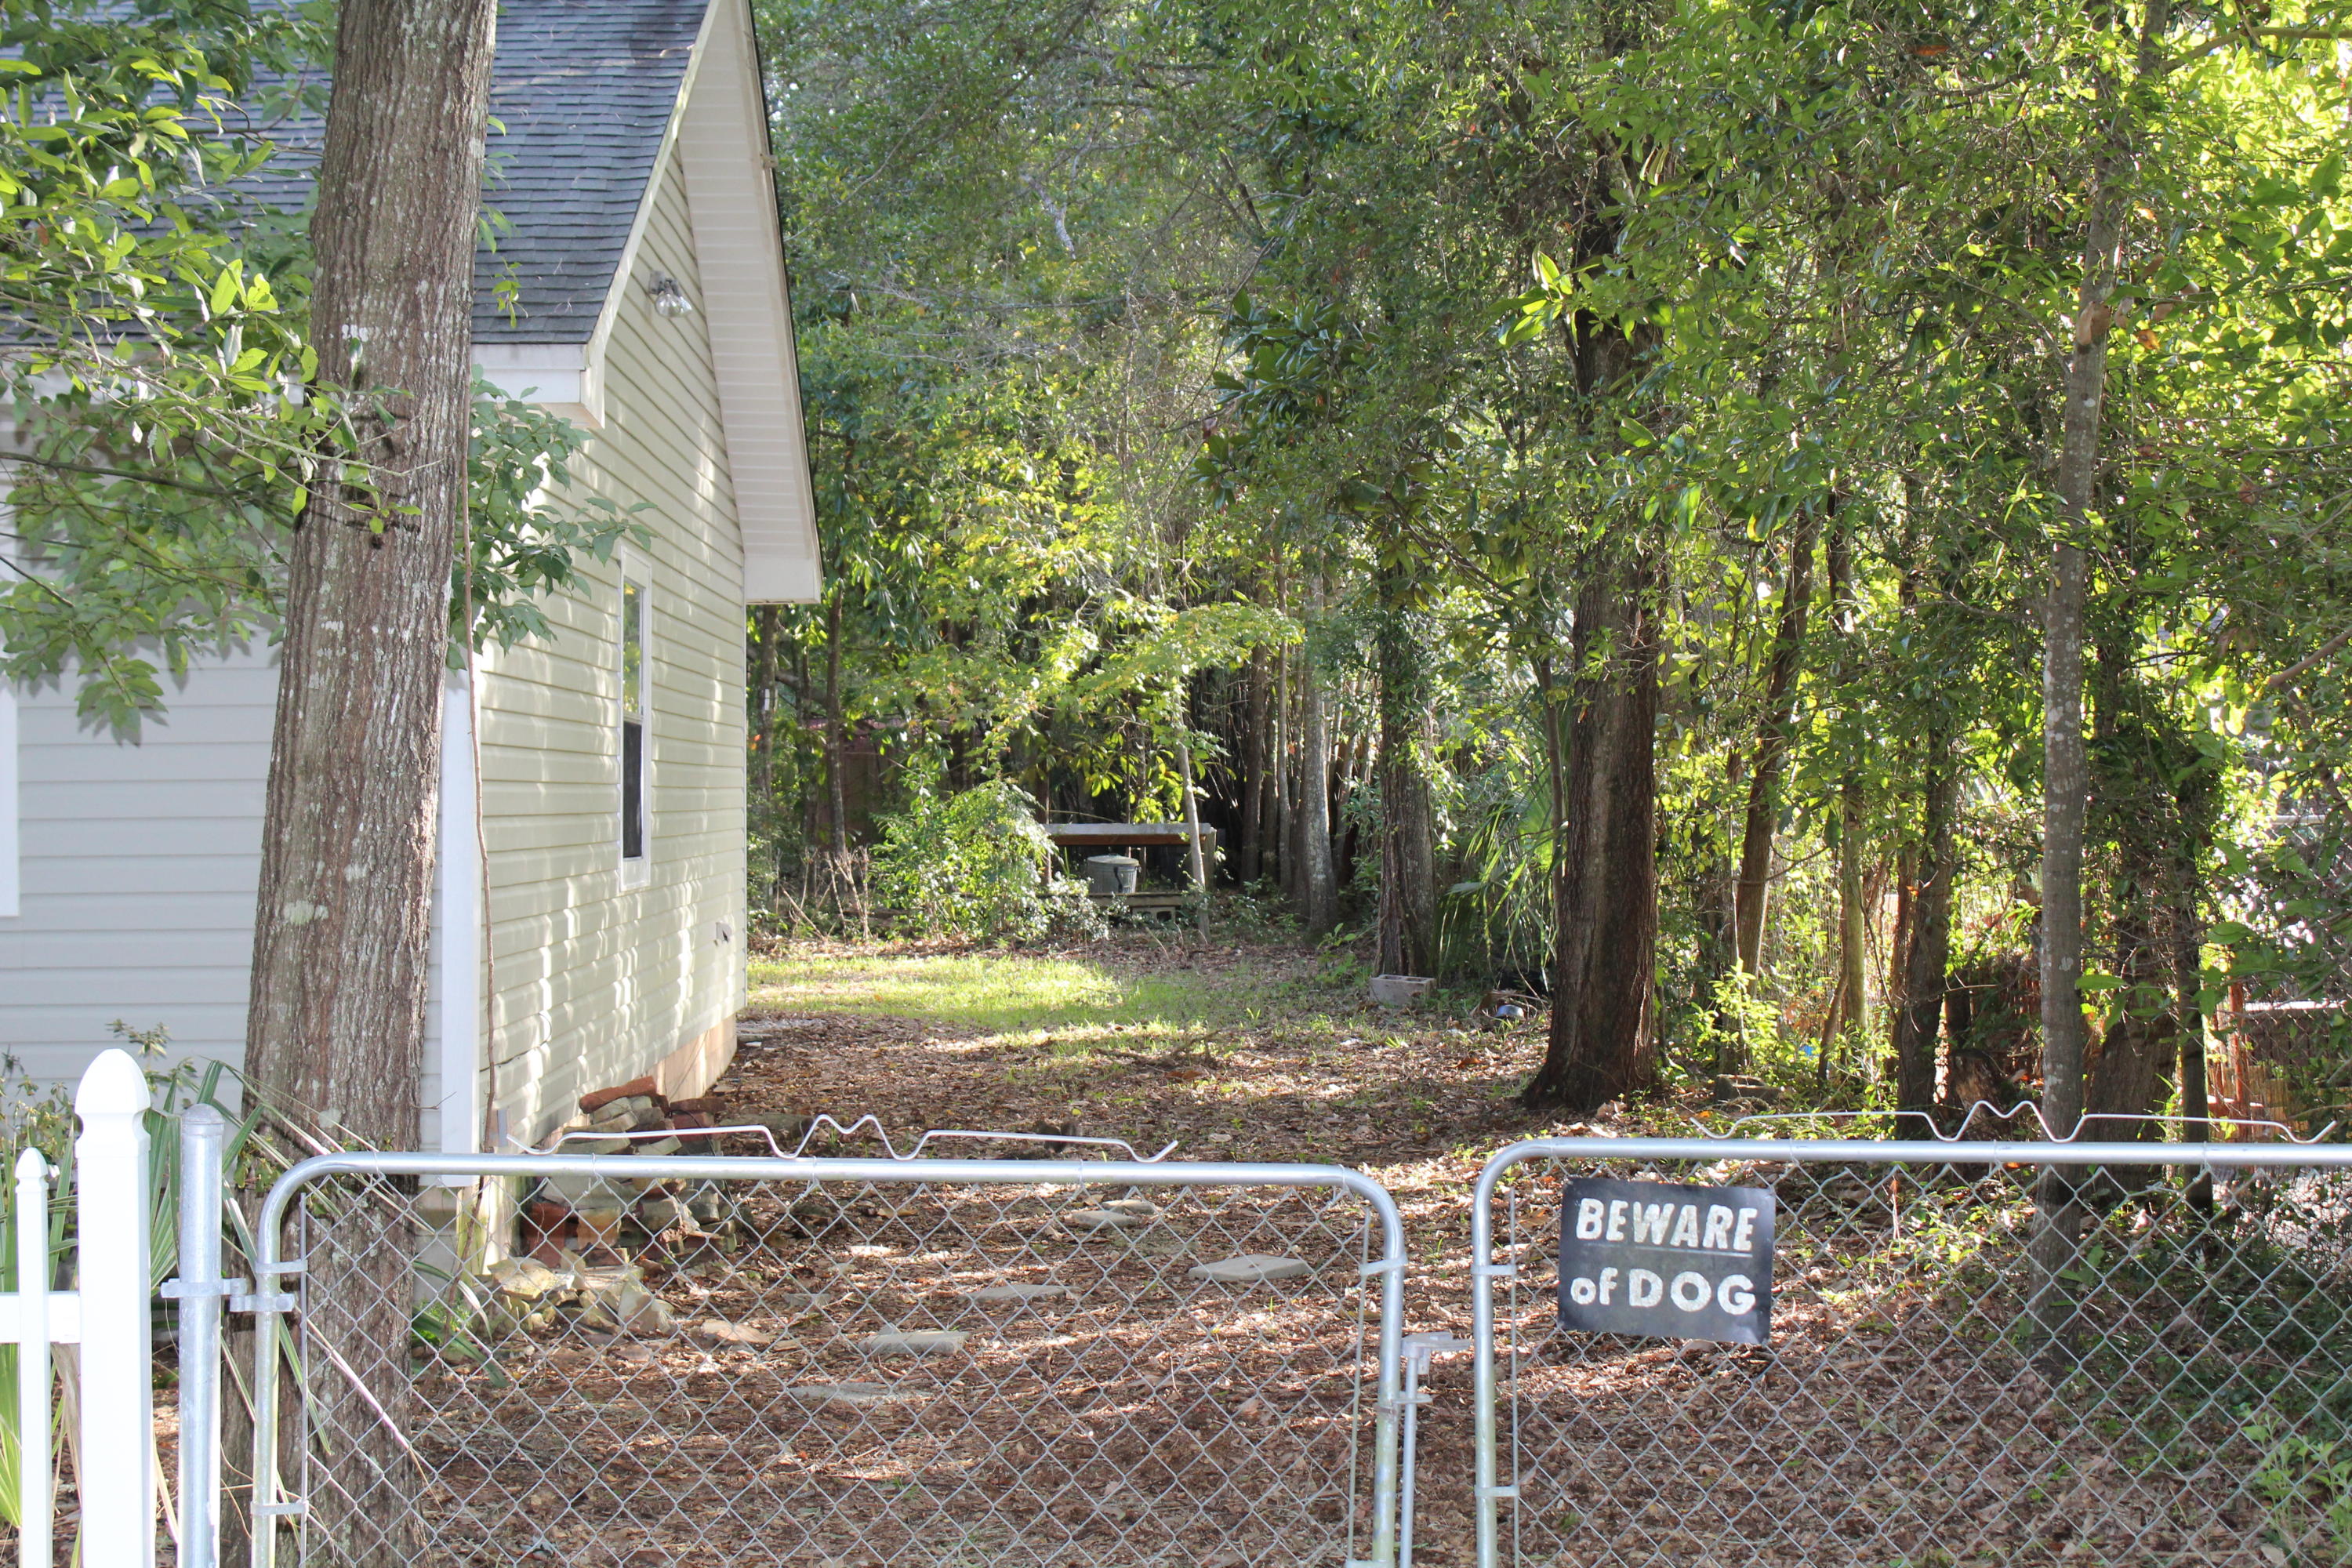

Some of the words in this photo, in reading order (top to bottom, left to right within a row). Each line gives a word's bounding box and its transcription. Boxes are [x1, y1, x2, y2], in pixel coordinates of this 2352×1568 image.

[1576, 1197, 1758, 1250] BEWARE
[1570, 1267, 1618, 1305] of
[1628, 1268, 1756, 1315] DOG
